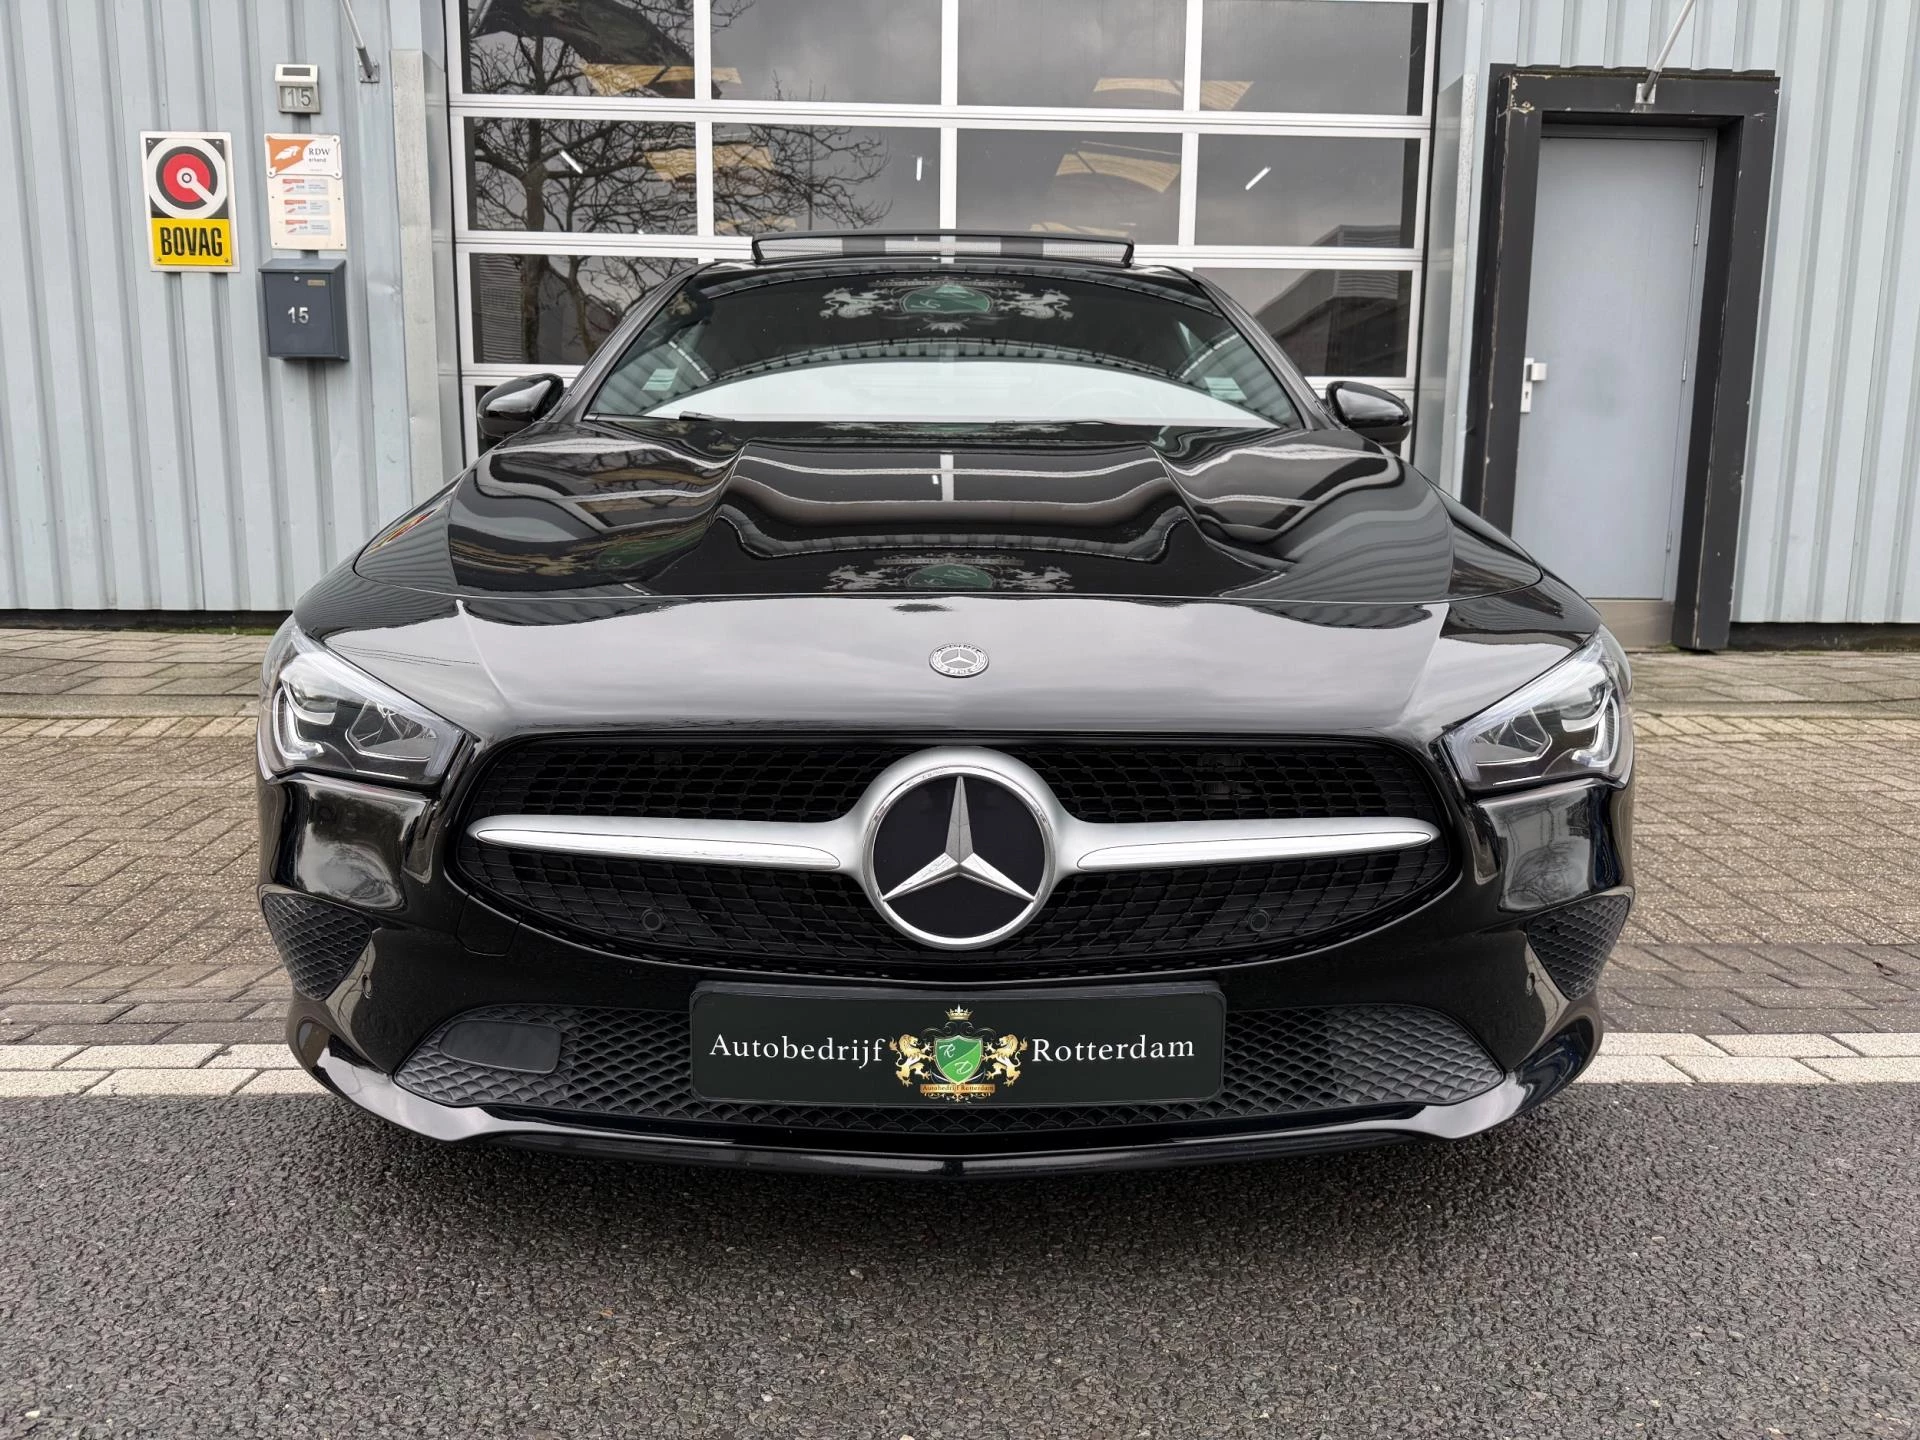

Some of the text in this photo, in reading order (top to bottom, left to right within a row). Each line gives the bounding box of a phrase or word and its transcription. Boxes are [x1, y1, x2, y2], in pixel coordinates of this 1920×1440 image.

[287, 88, 312, 107] 15
[308, 147, 330, 156] RDW
[159, 226, 223, 257] BOVAG
[287, 306, 309, 324] 15
[709, 1033, 1195, 1068] Autobedrijf Rotterdam
[922, 1084, 994, 1094] Autobedrijf Rotterdam
